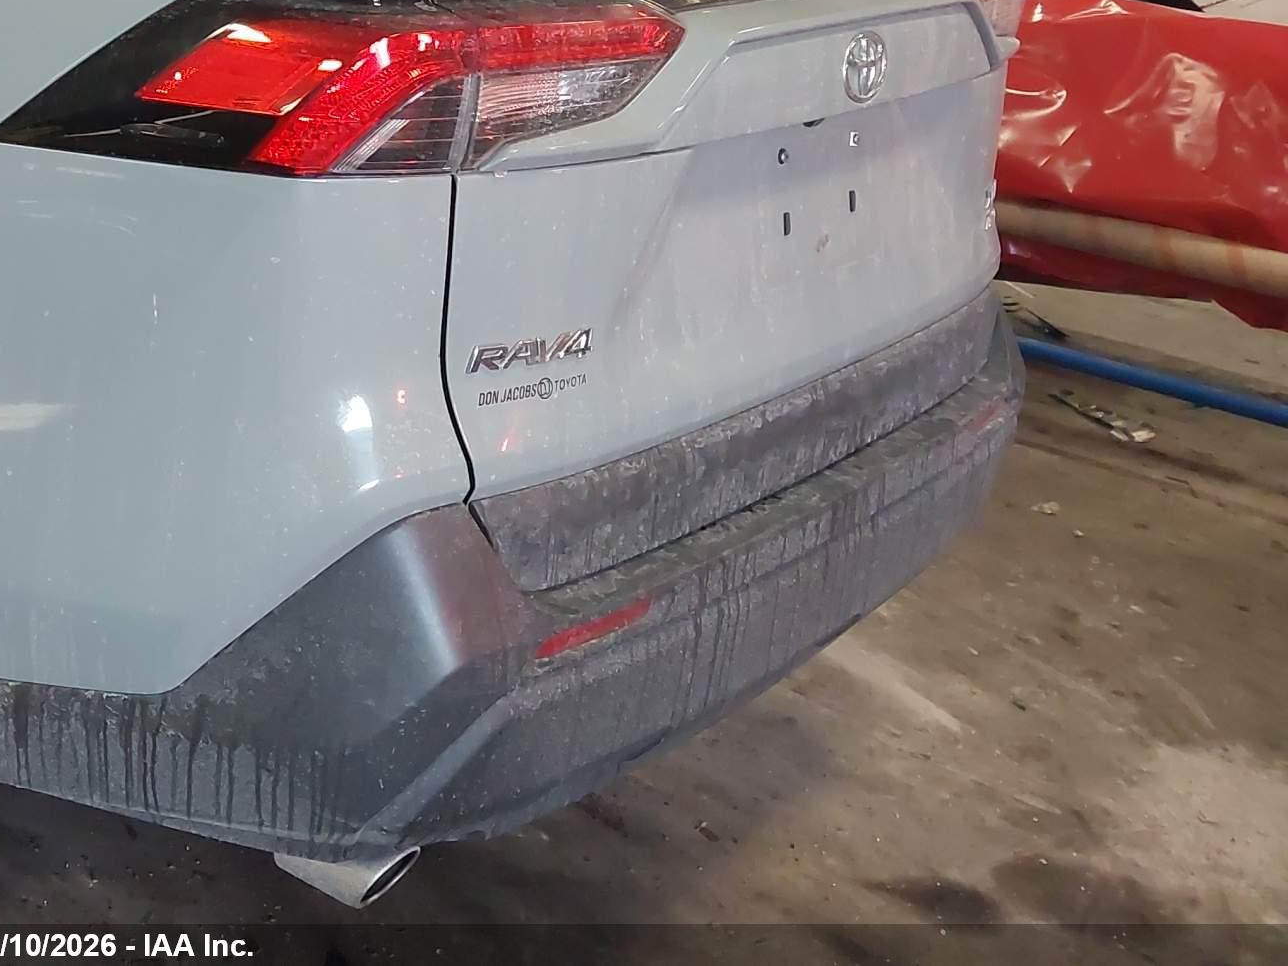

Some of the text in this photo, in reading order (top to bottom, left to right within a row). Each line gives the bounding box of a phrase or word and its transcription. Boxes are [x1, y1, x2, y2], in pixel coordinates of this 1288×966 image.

[465, 329, 593, 374] RAV4
[478, 390, 500, 406] DON
[500, 384, 538, 402] JACOBS
[554, 373, 587, 391] TOYOTA
